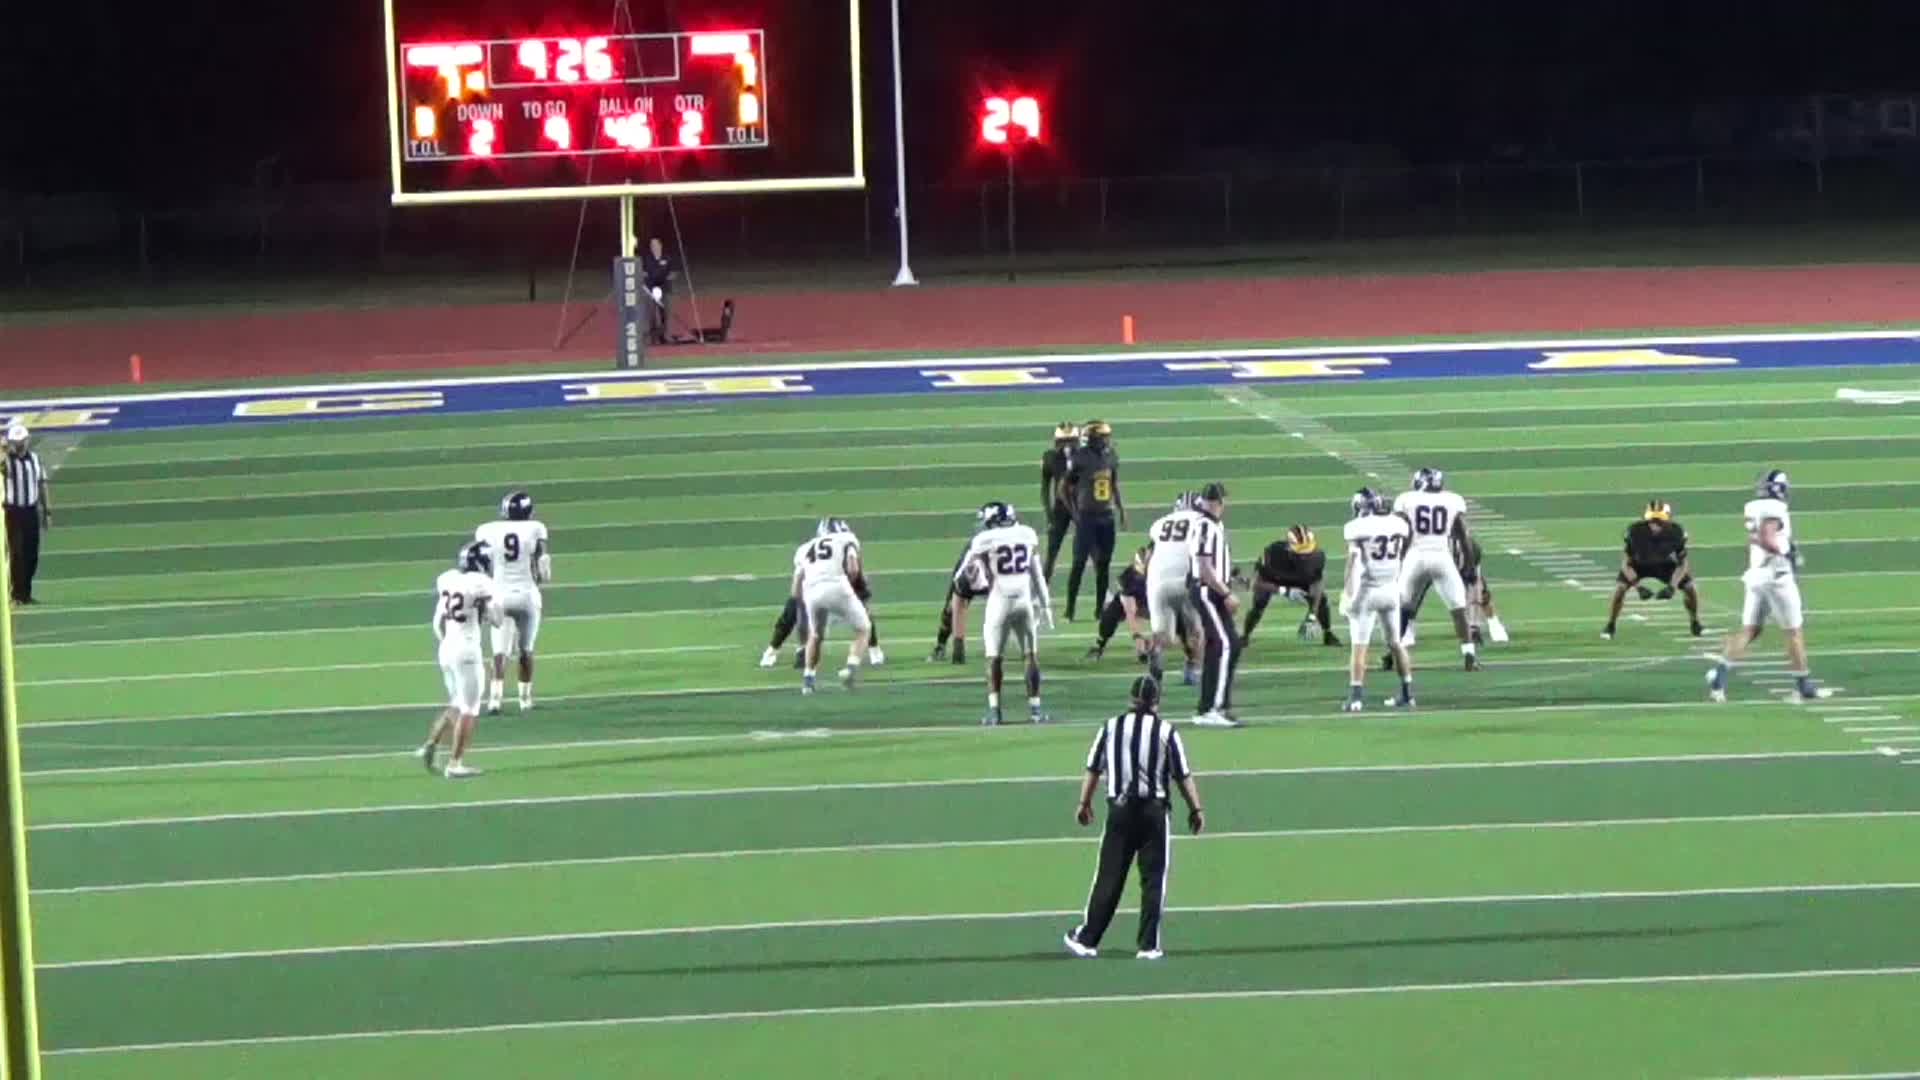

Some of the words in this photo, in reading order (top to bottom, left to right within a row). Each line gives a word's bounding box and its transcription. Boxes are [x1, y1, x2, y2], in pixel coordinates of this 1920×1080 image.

[457, 104, 504, 121] DOWN
[523, 103, 542, 118] TO
[544, 101, 566, 117] GO
[674, 95, 705, 112] QTR
[544, 116, 571, 149] 9
[679, 110, 704, 147] 2
[982, 97, 1041, 145] 29
[469, 119, 495, 156] 2
[1094, 470, 1113, 501] 8
[1159, 519, 1190, 542] 99
[1415, 505, 1448, 535] 60
[504, 533, 519, 561] 9
[805, 538, 832, 563] 45
[996, 544, 1029, 574] 22
[1371, 533, 1401, 560] 33
